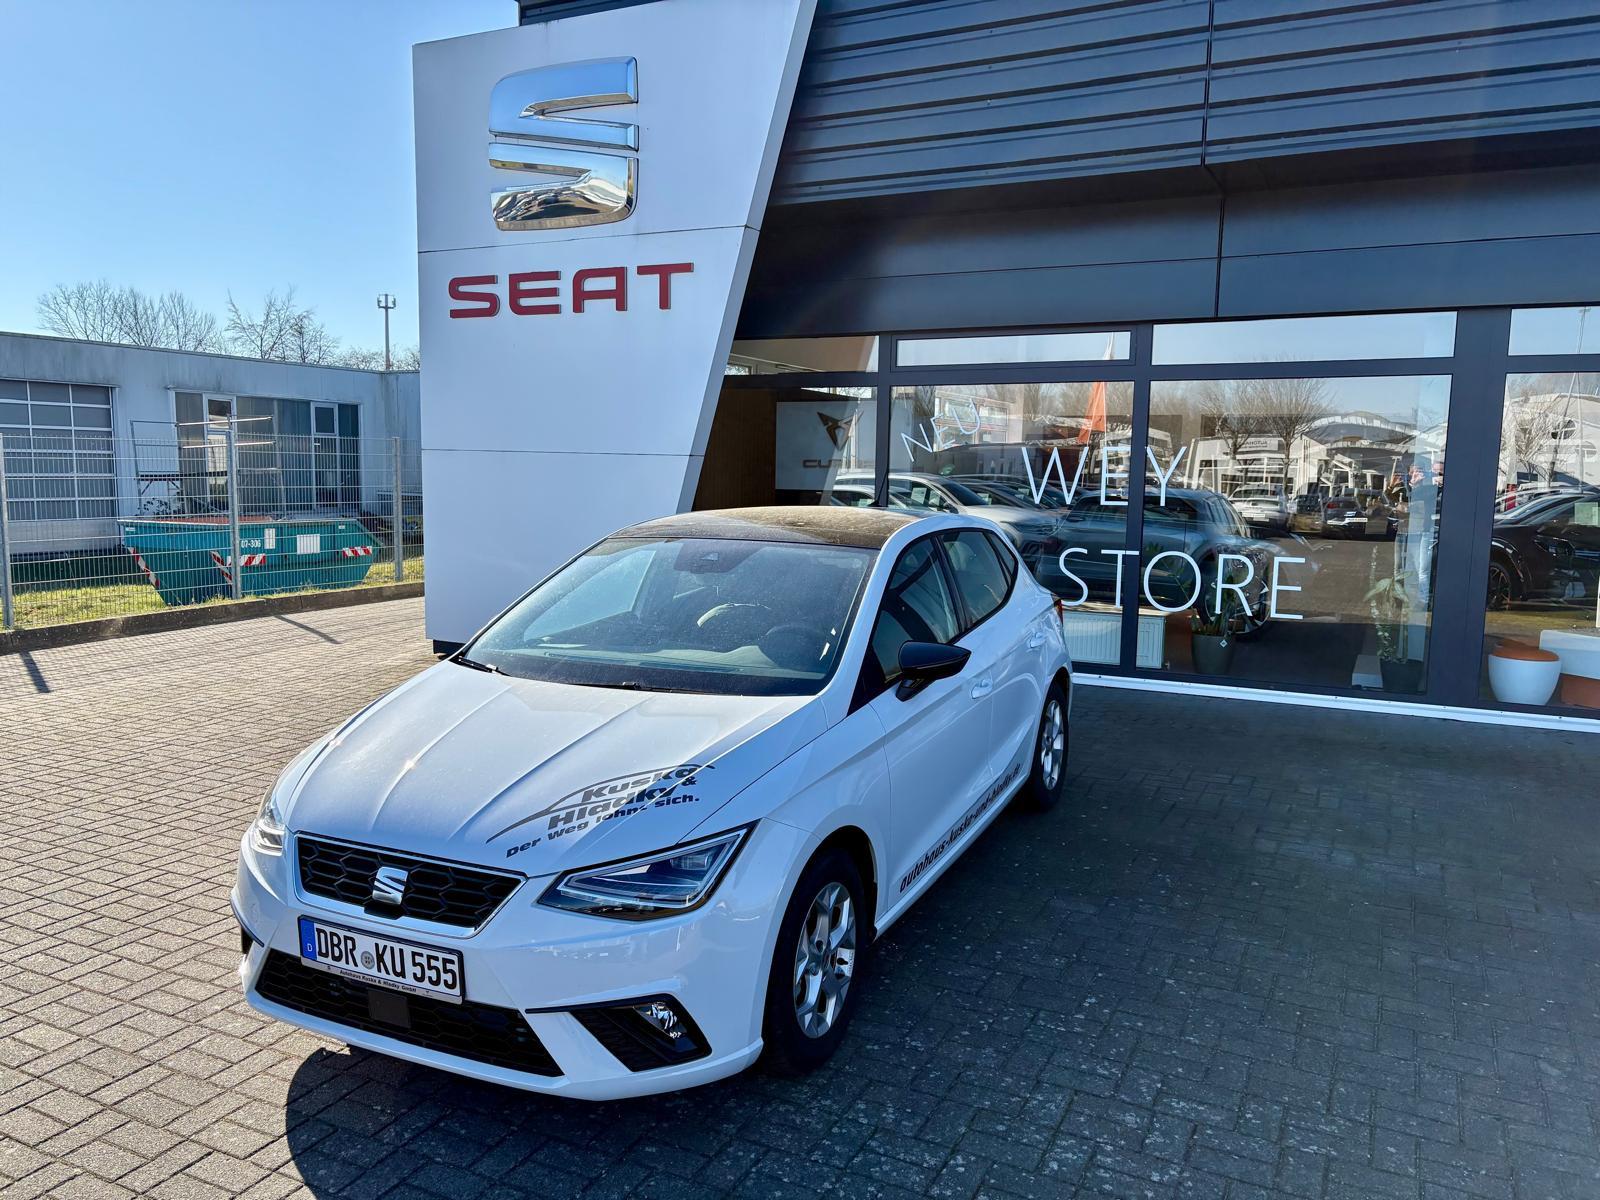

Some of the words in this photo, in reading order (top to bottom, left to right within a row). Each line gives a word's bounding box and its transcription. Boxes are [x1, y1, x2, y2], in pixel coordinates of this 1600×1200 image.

[448, 262, 695, 319] SEAT
[901, 398, 980, 462] NEU
[1022, 446, 1187, 507] WEY
[1059, 547, 1306, 620] STORE
[581, 766, 699, 803] Kuska
[505, 837, 542, 858] Der
[547, 821, 590, 841] Weg
[654, 794, 701, 808] sich.
[315, 927, 359, 968] DBR
[374, 942, 407, 979] KU
[411, 951, 458, 990] 555
